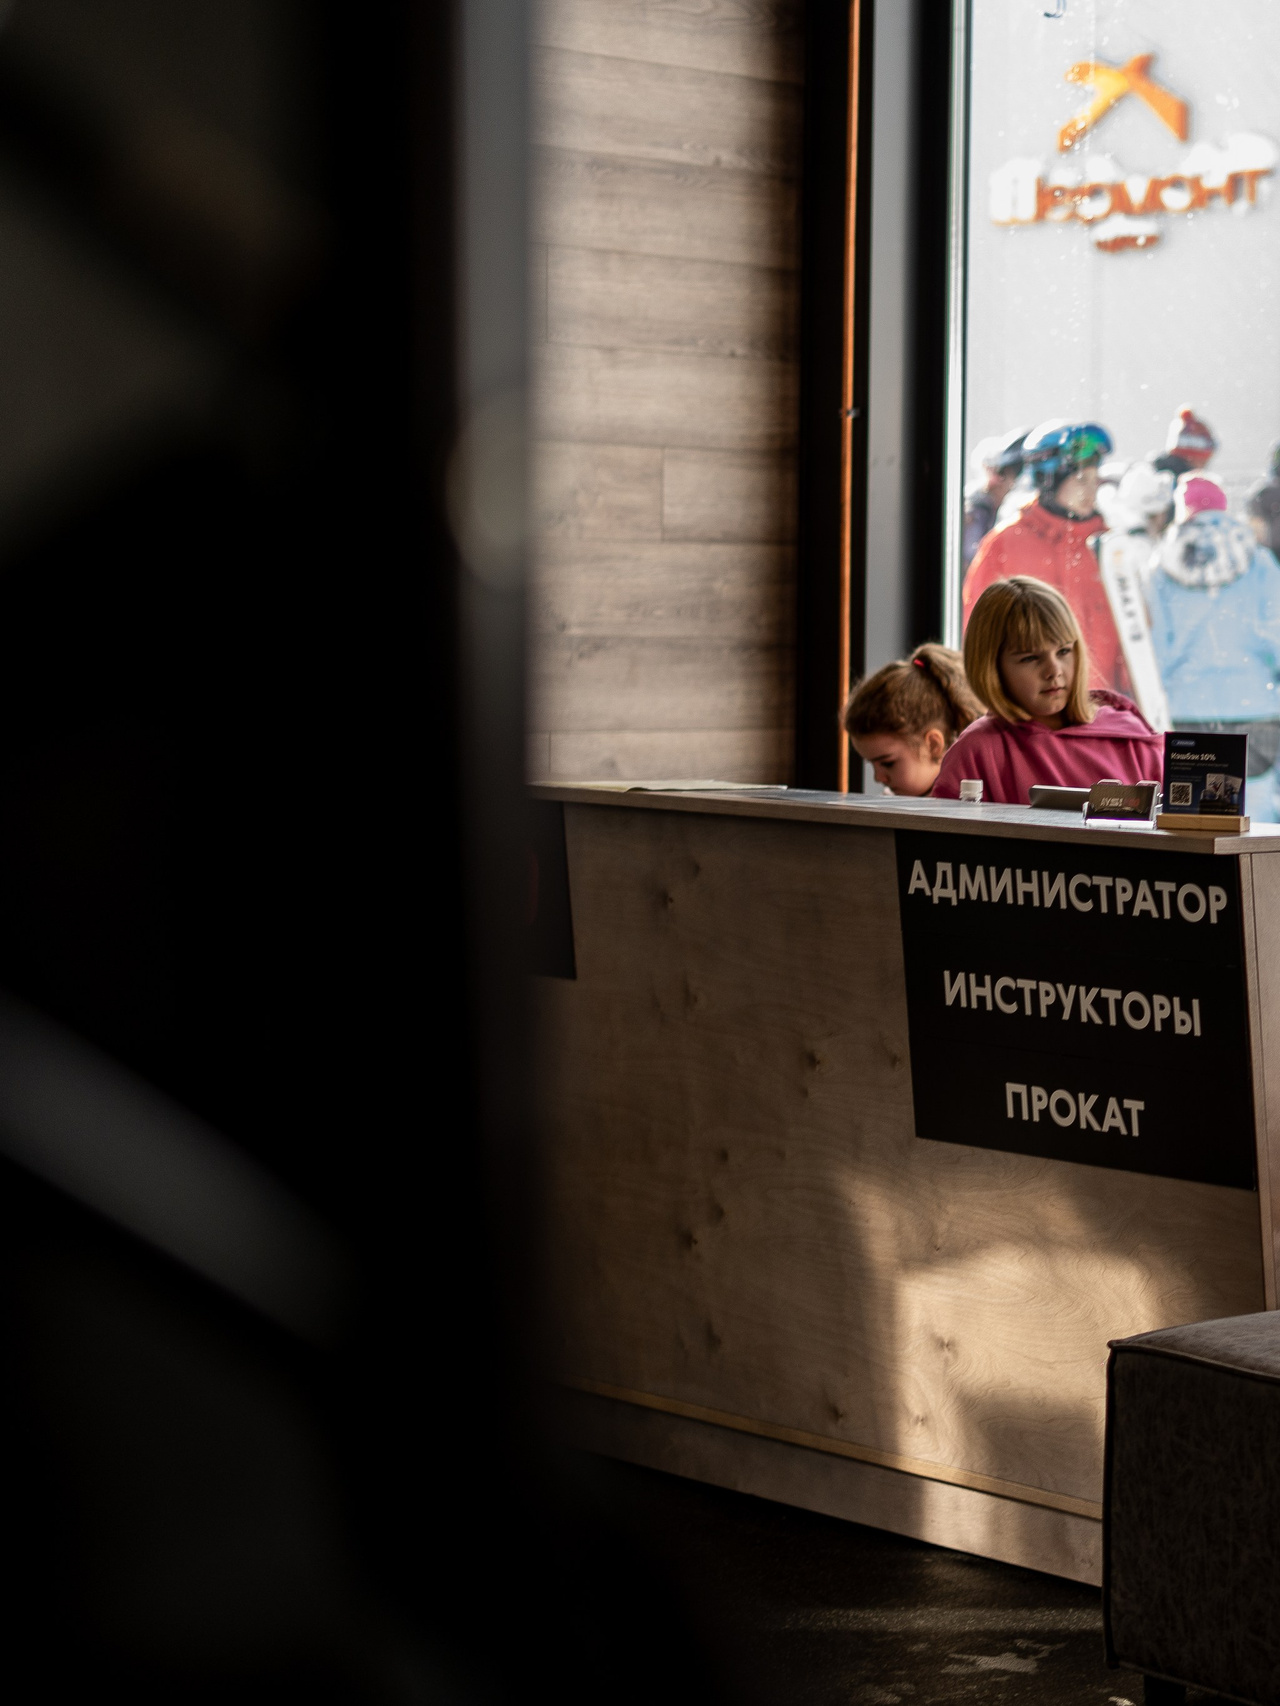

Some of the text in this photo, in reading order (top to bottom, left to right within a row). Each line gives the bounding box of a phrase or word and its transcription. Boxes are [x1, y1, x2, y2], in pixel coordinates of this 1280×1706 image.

[907, 859, 1228, 924] АДМИНИСТРАТОР
[943, 970, 1201, 1036] ИНСТРУКТОРЫ
[1005, 1082, 1145, 1137] ПРОКАТ
